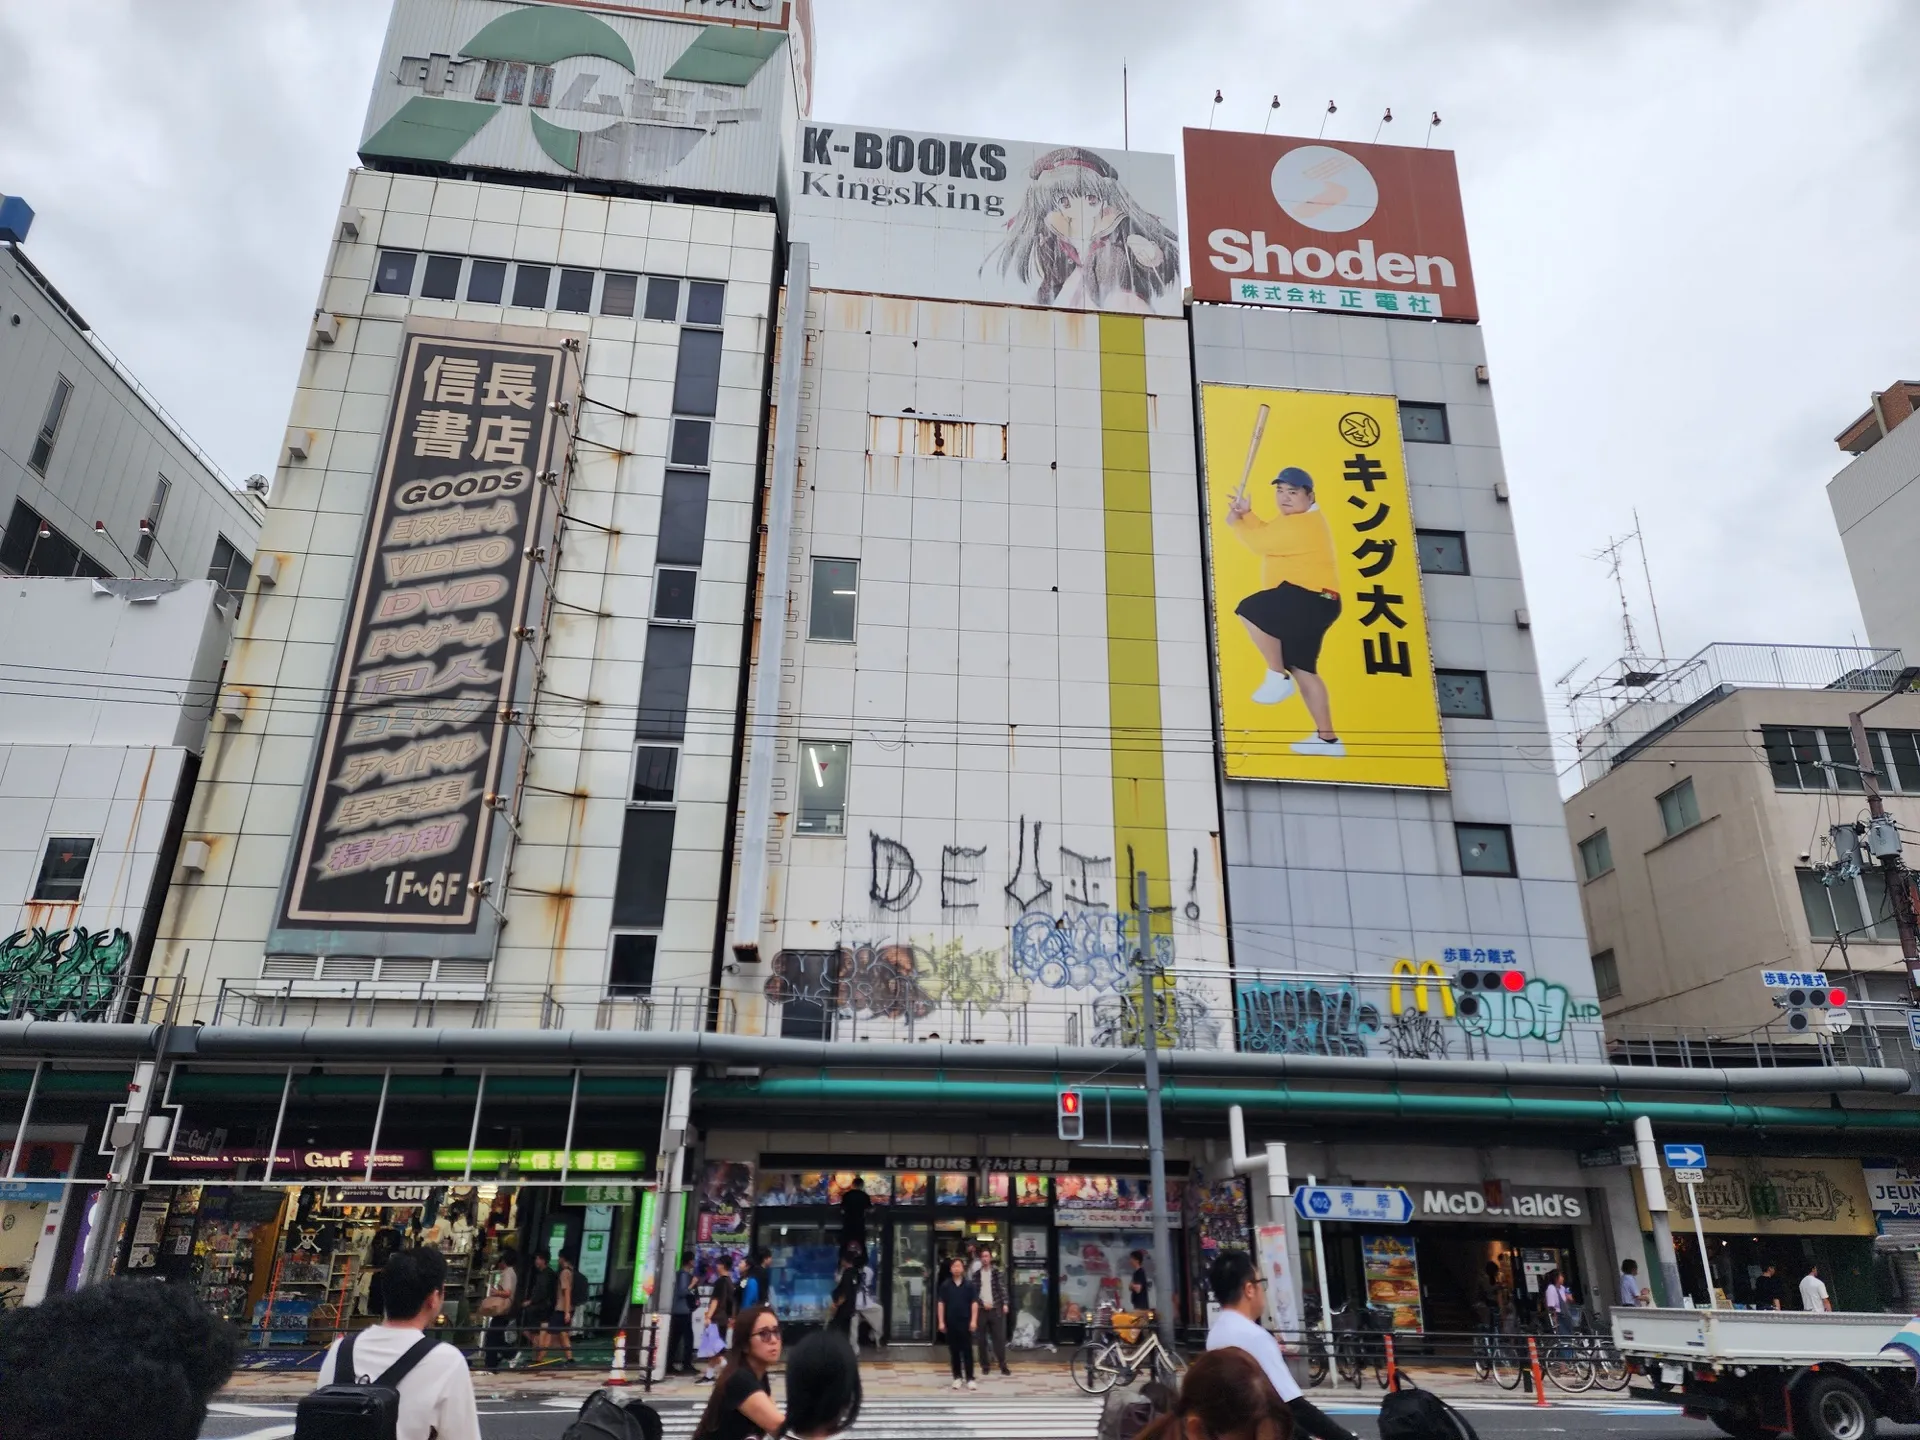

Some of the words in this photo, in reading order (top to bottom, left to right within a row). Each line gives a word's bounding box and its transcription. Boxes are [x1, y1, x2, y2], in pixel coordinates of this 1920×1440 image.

[802, 126, 1007, 181] K-BOOKS
[800, 171, 1005, 216] KingsKing
[1207, 228, 1457, 287] Shoden
[423, 355, 537, 410] 信長
[412, 409, 532, 465] 書店
[401, 470, 524, 505] GOODS
[390, 539, 508, 578] VIDEO
[1343, 453, 1413, 677] キング大山
[380, 579, 502, 617] DVD
[369, 614, 496, 657] PCゲーム
[360, 658, 488, 700] 同人
[354, 699, 486, 737] コミック
[347, 738, 479, 784] アイドル
[338, 779, 465, 823] 写真集
[327, 819, 460, 871] 精力剤
[1443, 948, 1517, 964] 歩車分離式
[1764, 972, 1827, 987] 歩車分離式
[304, 1150, 354, 1168] Guf
[885, 1157, 973, 1170] K-BOOKS
[1677, 1171, 1702, 1181] ここから
